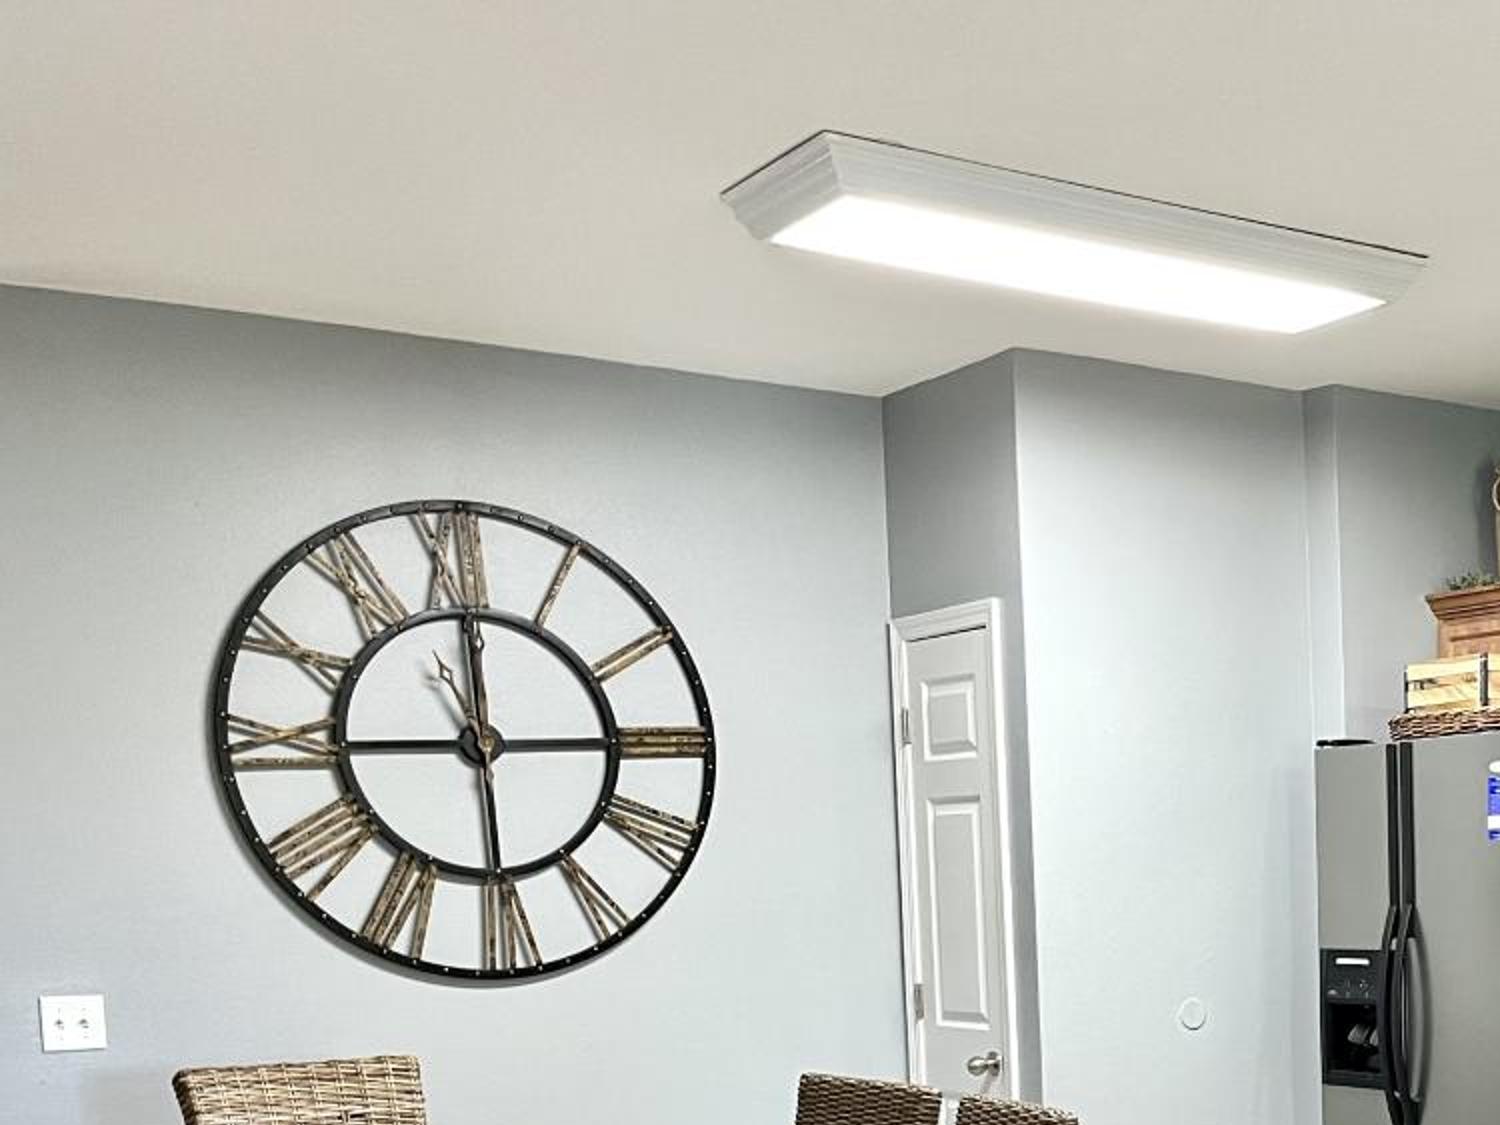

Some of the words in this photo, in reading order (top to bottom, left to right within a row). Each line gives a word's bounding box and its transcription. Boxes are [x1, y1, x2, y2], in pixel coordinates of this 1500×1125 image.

[306, 531, 410, 638] XI
[413, 508, 490, 610] XII
[240, 608, 353, 690] X
[591, 624, 673, 682] II
[226, 712, 338, 770] IX
[616, 726, 706, 759] III
[267, 795, 378, 900] VIII
[362, 854, 437, 960] VII
[486, 876, 543, 970] VI
[558, 853, 632, 938] V
